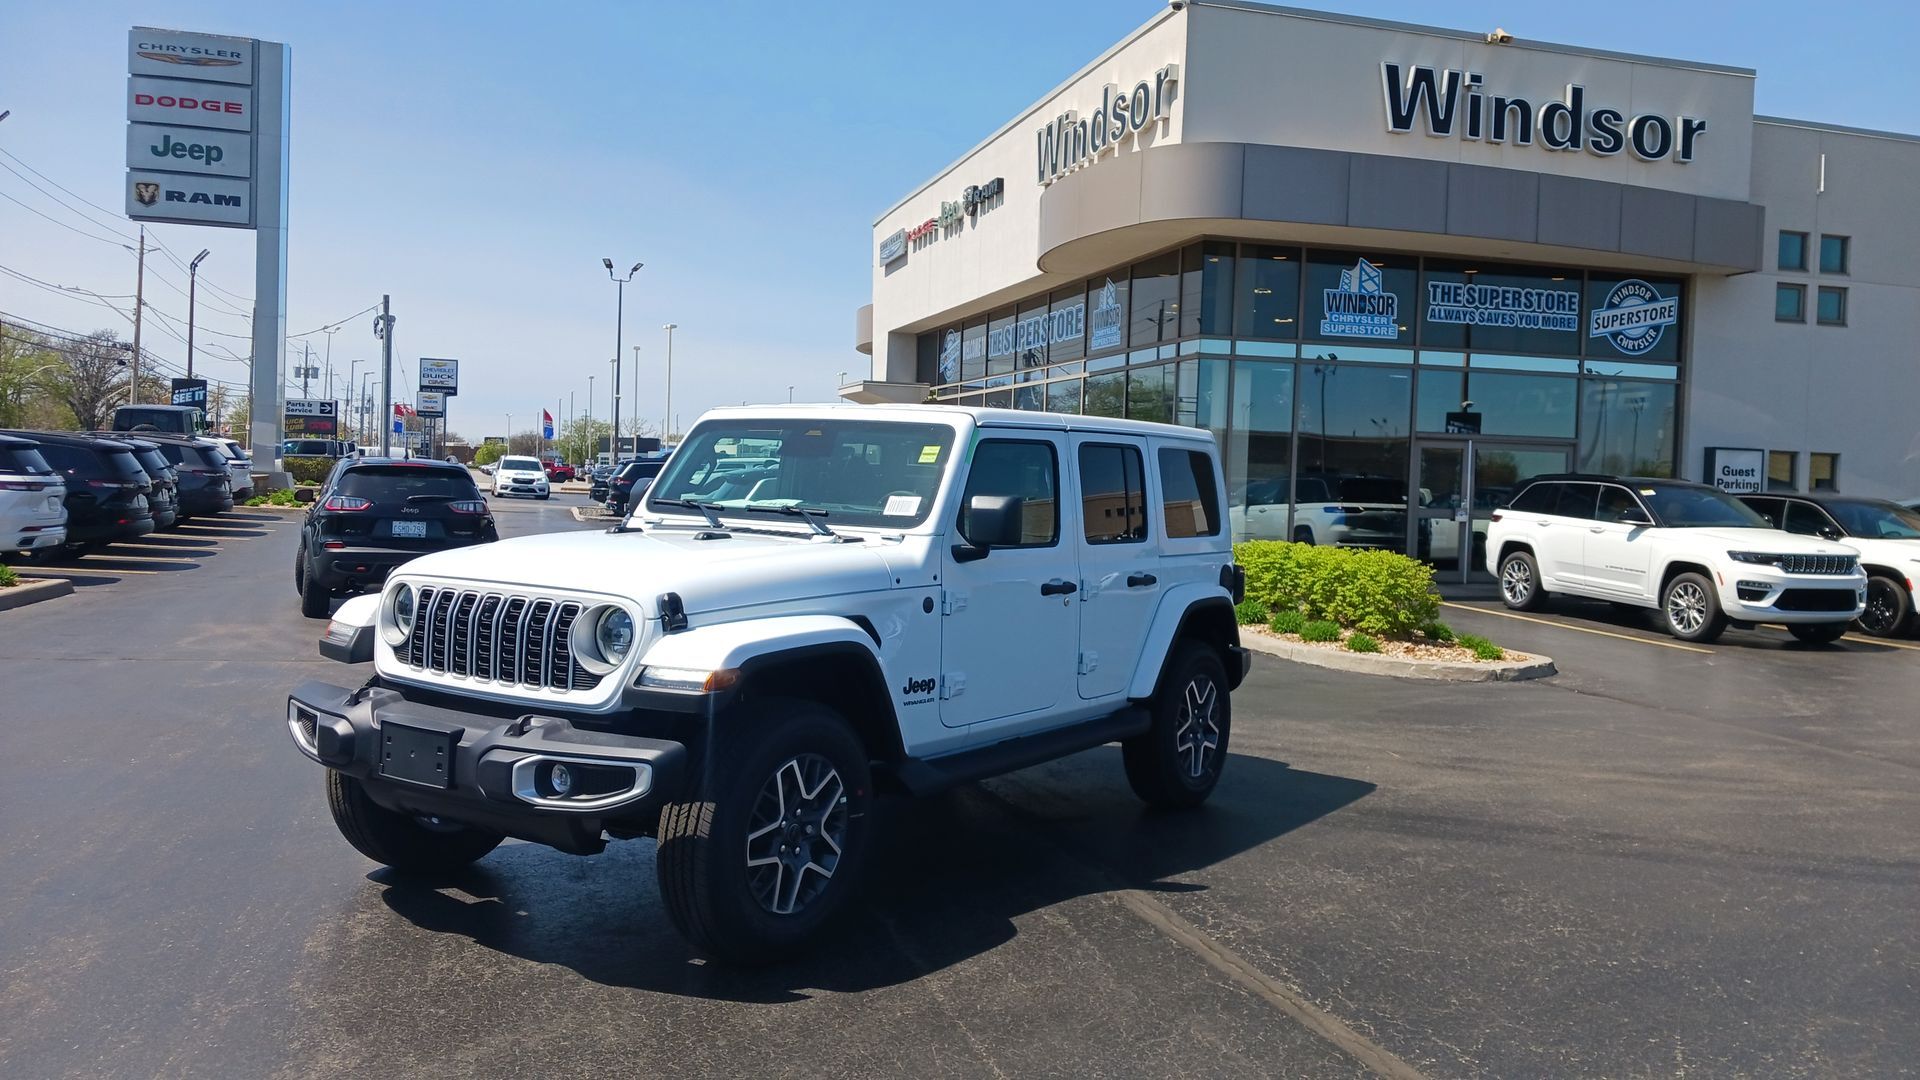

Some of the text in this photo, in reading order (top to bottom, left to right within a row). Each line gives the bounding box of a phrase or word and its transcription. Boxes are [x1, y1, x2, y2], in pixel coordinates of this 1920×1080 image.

[138, 42, 241, 59] CHRYSLER
[135, 94, 242, 114] DODGE
[1381, 61, 1706, 163] Windsor
[1037, 65, 1177, 186] Windsor
[151, 135, 223, 165] Jeep
[165, 190, 241, 207] RAM
[973, 177, 1004, 204] RAM
[1326, 292, 1395, 316] WINDSOR
[1429, 283, 1578, 313] THE SUPERSTORE
[1611, 285, 1652, 305] WINDSOR
[1331, 314, 1388, 325] CHRYSLER
[1429, 307, 1577, 330] ALWAYS SAVES YOU MORE!
[1593, 304, 1674, 331] SUPERSTORE
[1003, 305, 1084, 355] SUPERSTORE
[1323, 323, 1396, 336] SUPERSTORE
[1617, 328, 1657, 350] CHRYSLER
[173, 390, 206, 404] SEE IT
[1722, 465, 1756, 478] Guest
[1716, 478, 1760, 493] Parking
[903, 677, 936, 695] Jeep
